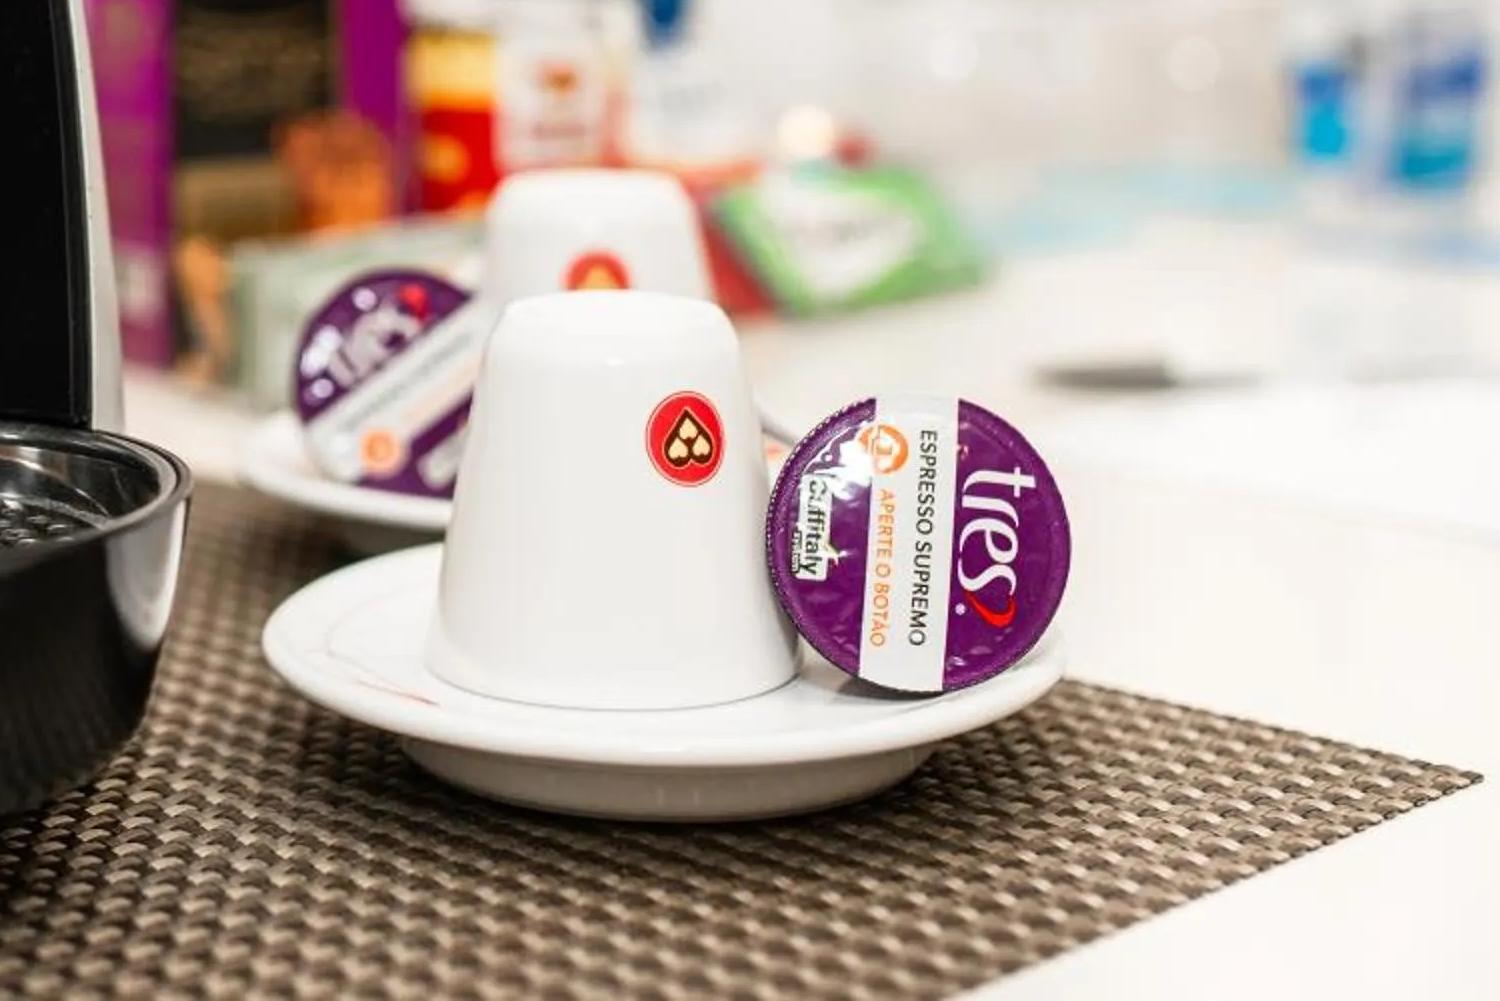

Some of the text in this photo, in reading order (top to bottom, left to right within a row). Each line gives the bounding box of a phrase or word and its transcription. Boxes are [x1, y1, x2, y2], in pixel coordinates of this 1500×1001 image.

[875, 489, 895, 558] APERTE
[908, 430, 938, 647] ESPRESSO SUPREMO
[874, 563, 891, 578] O
